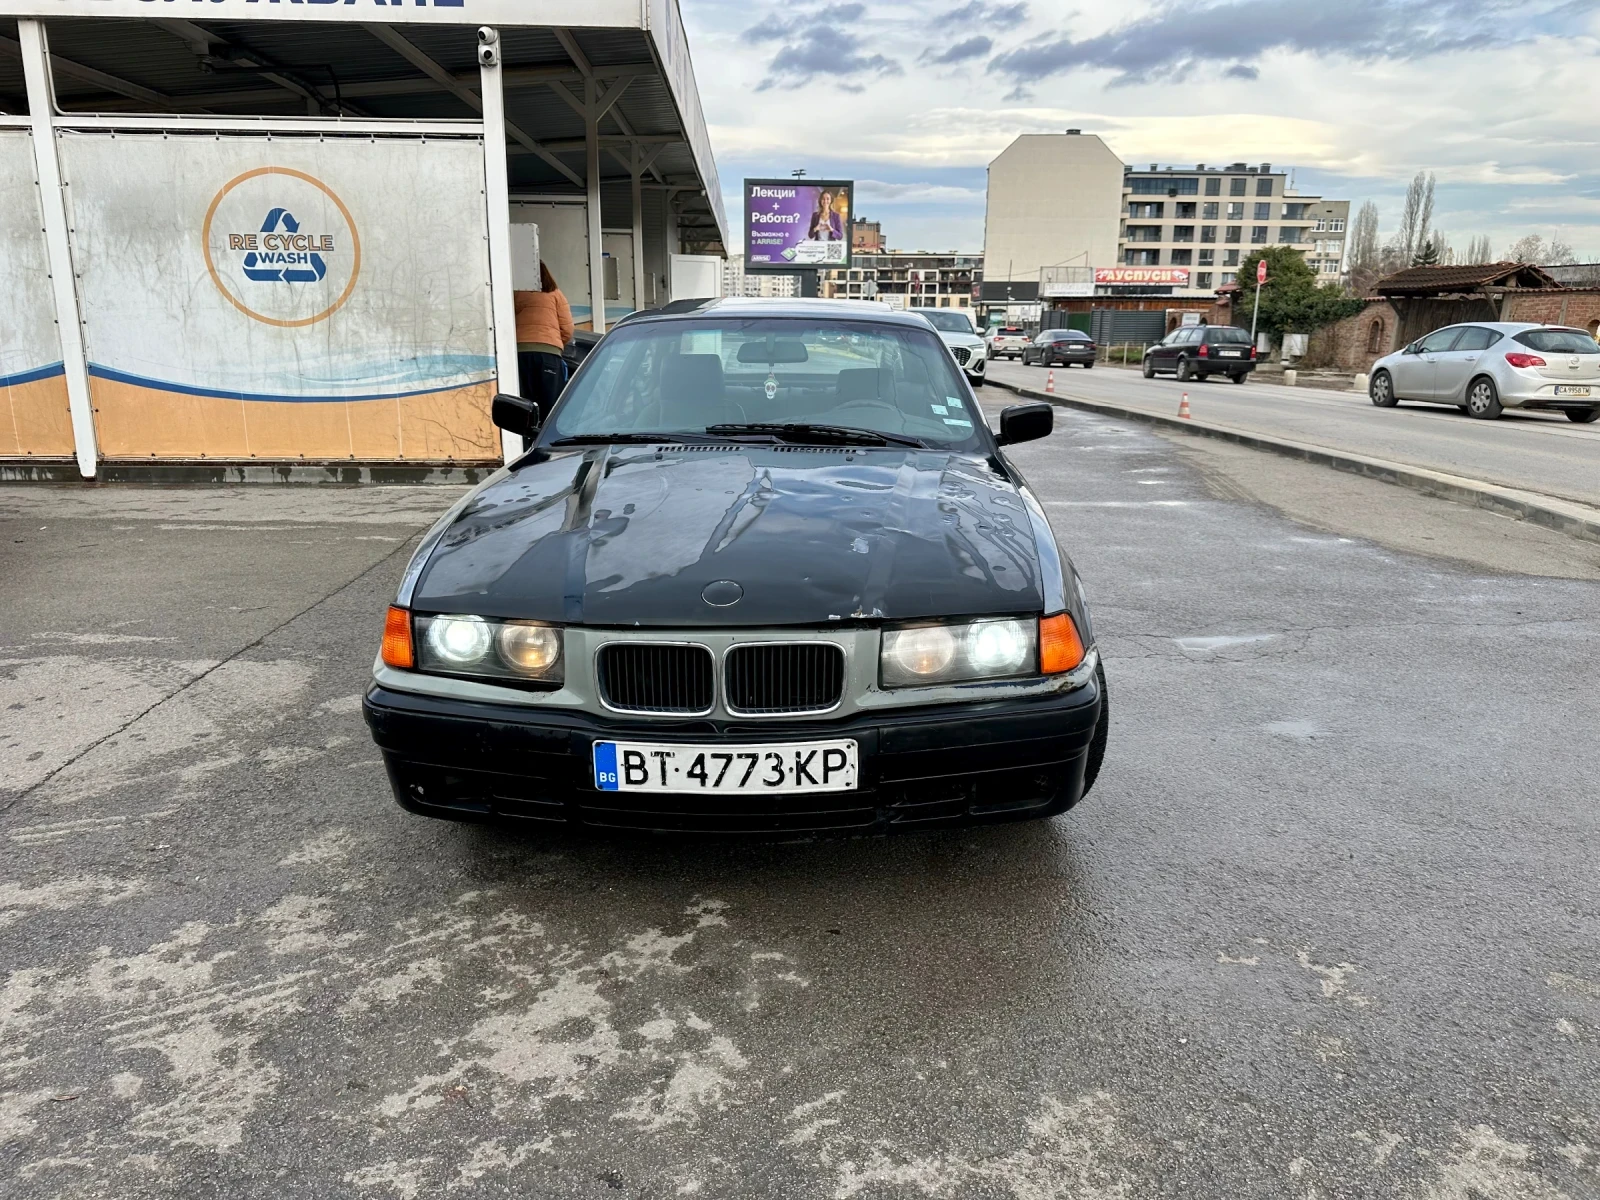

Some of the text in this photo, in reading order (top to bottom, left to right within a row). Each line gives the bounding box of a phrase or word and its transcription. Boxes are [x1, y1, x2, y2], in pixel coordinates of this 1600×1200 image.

[751, 187, 796, 199] Лекции
[751, 212, 800, 223] Работа?
[229, 234, 335, 251] RE CYCLE
[259, 252, 308, 263] WASH
[1107, 270, 1172, 281] АУСПУСИ
[623, 748, 848, 787] BT 4773 KP
[599, 772, 616, 784] BG
